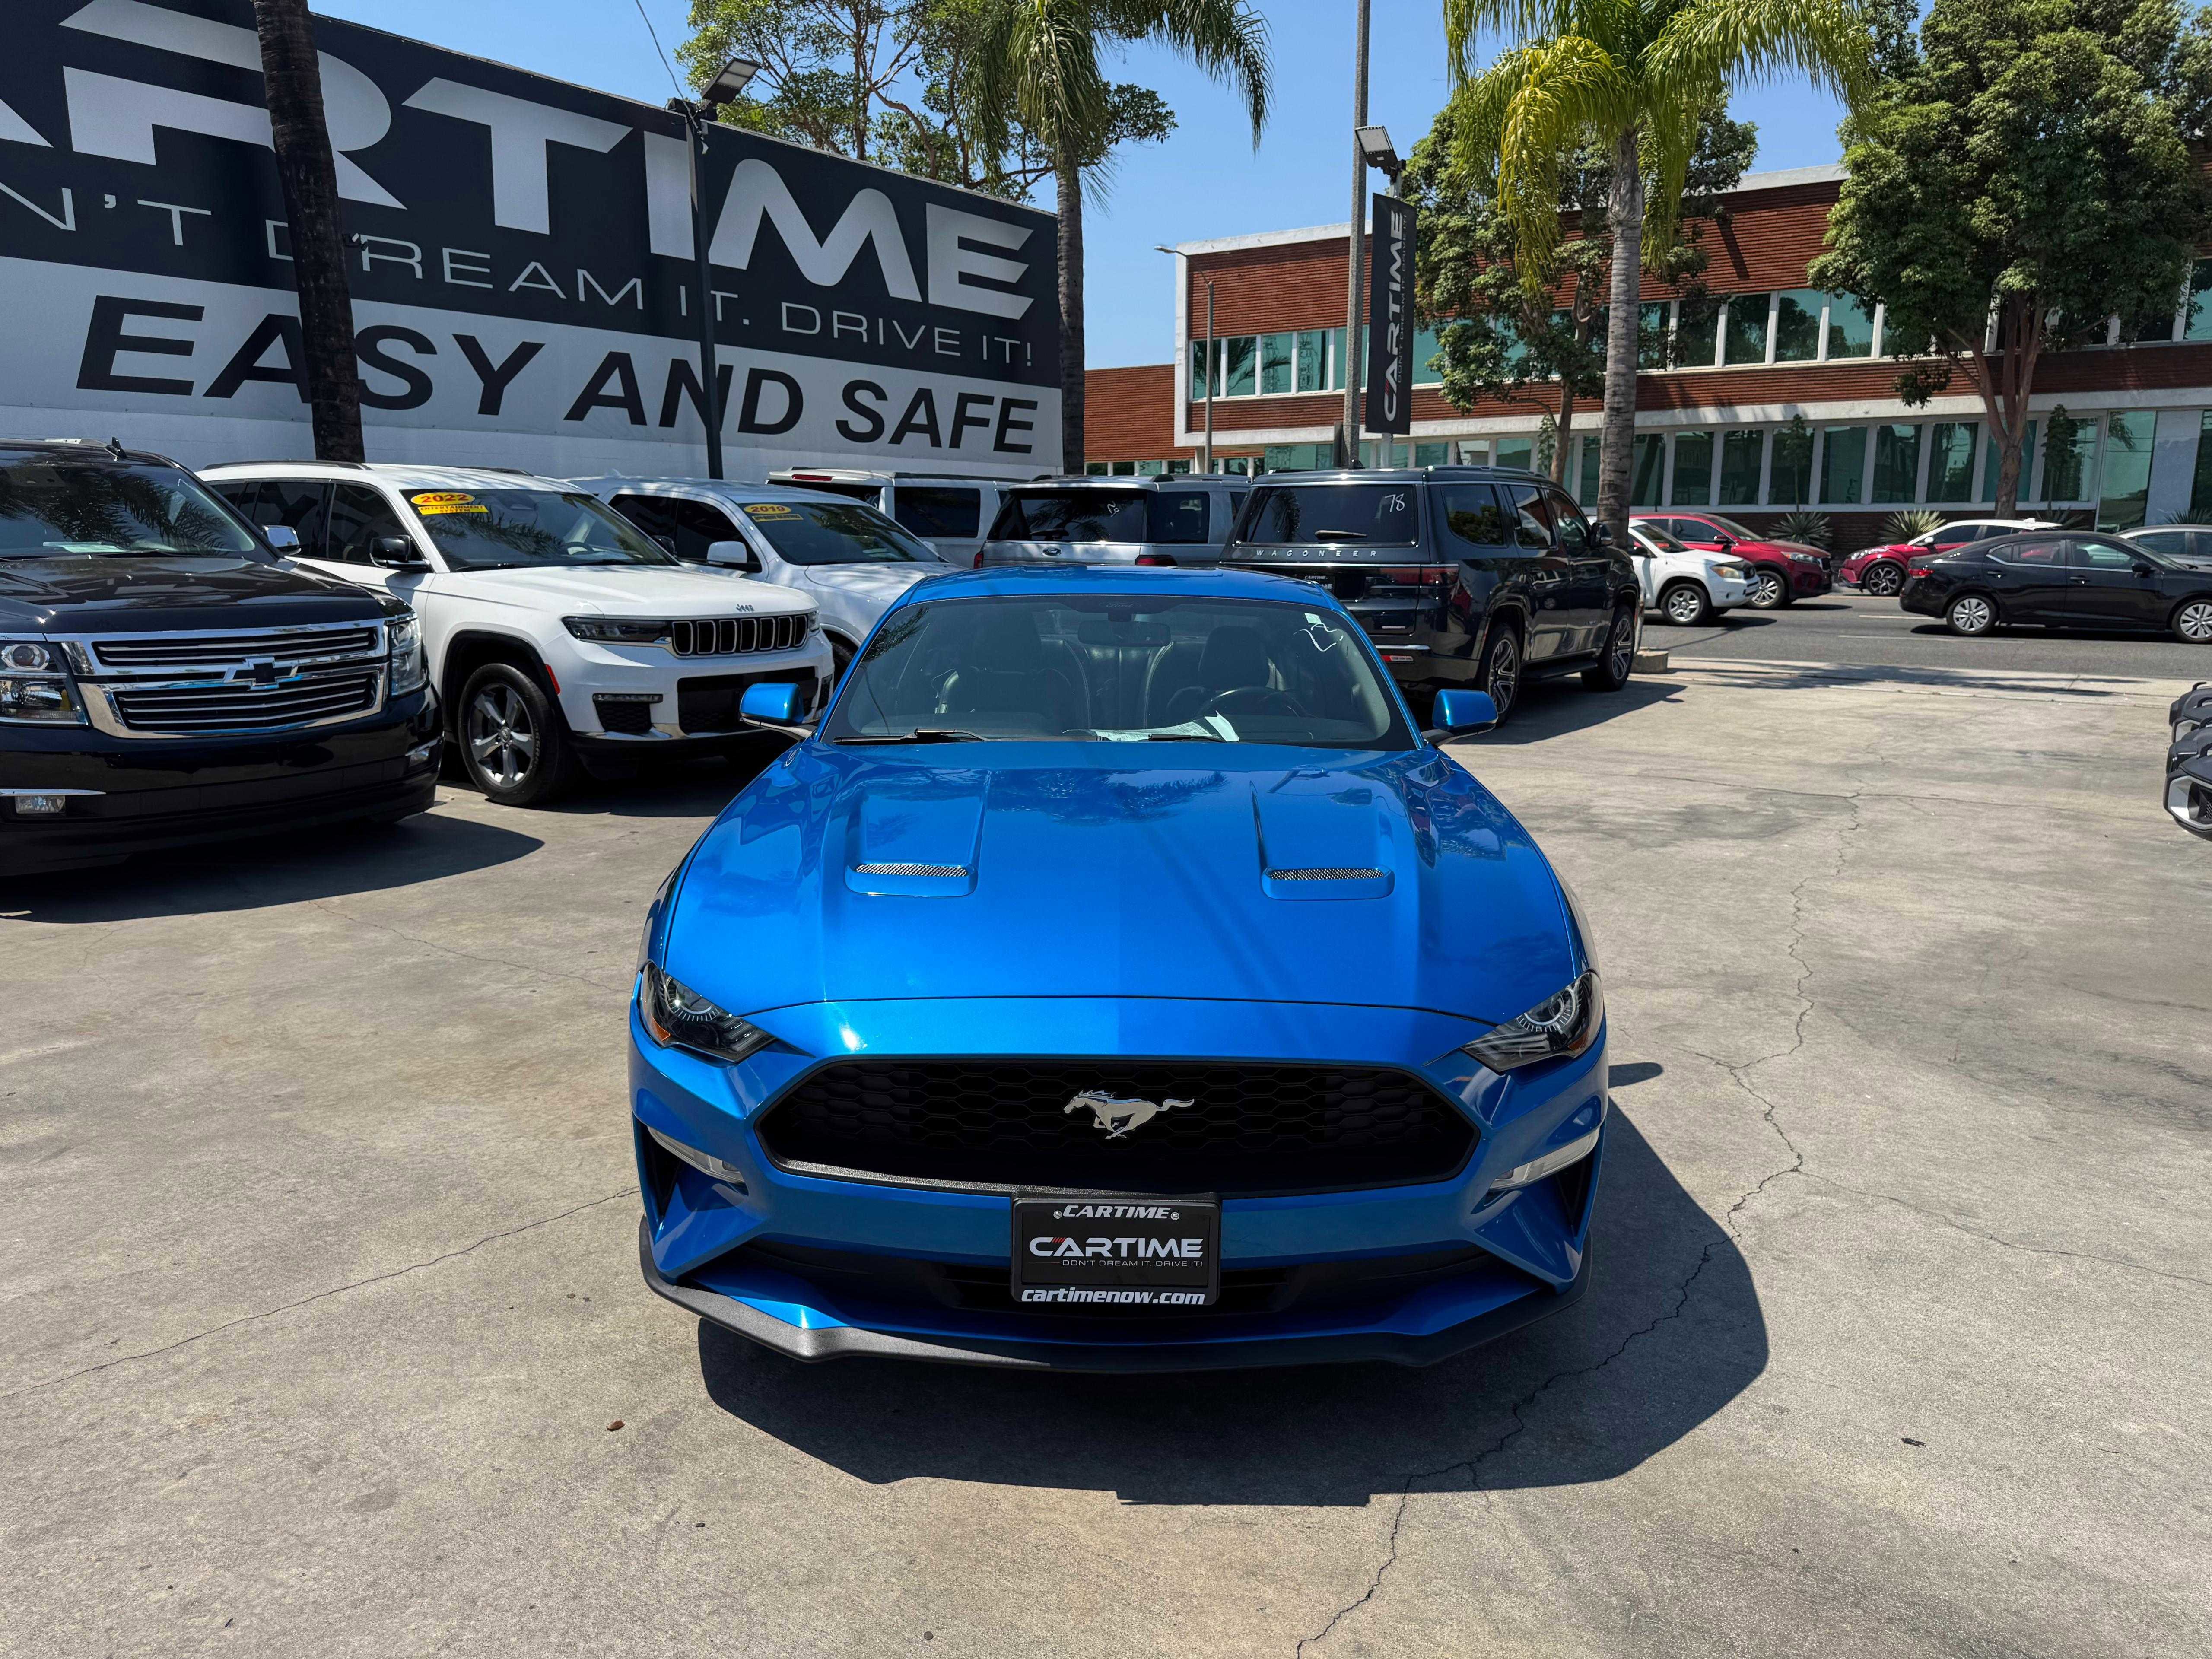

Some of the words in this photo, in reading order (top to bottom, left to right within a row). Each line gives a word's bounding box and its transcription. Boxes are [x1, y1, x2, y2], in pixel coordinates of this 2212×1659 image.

[0, 0, 1034, 320] RTIME
[680, 284, 750, 326] IT.
[781, 301, 962, 357] DRIVE
[982, 335, 1033, 367] IT!
[1384, 210, 1403, 422] CARTIME
[76, 295, 546, 416] EASY
[564, 350, 804, 435] AND
[835, 379, 1039, 454] SAFE
[420, 494, 469, 503] 2022
[1384, 493, 1406, 513] 78
[1062, 1205, 1171, 1219] CARTIME
[1029, 1236, 1204, 1258] CARTIME
[1021, 1287, 1206, 1305] cartimenow.com
